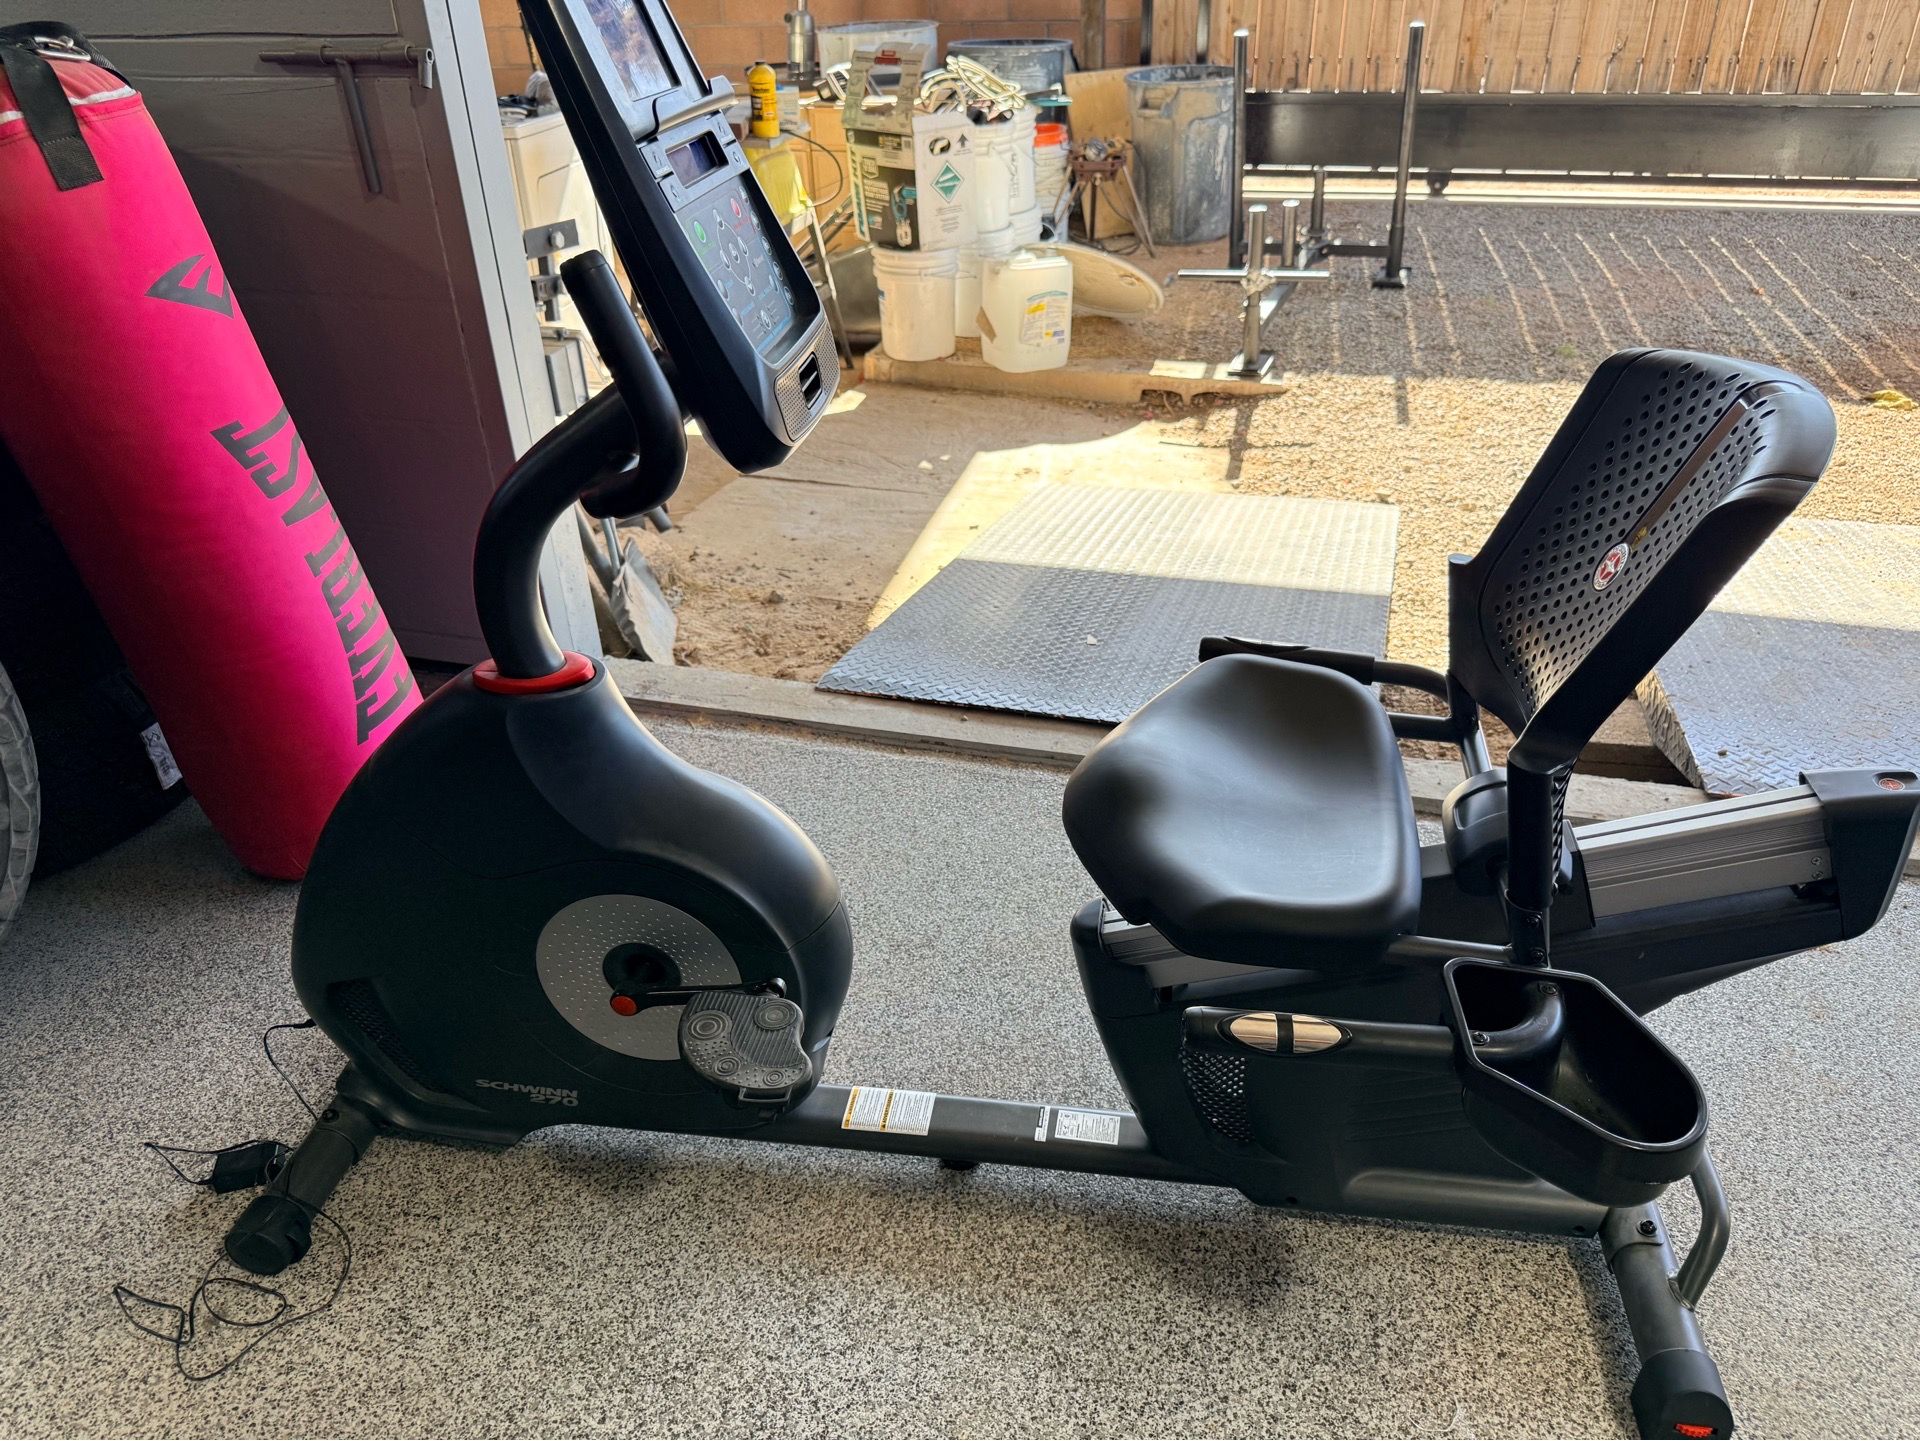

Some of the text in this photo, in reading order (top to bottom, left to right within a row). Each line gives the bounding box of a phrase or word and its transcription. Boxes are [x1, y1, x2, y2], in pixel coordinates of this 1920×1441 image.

[209, 403, 414, 746] EVERLAST
[475, 1079, 579, 1098] SCHWINN
[530, 1094, 579, 1107] 270
